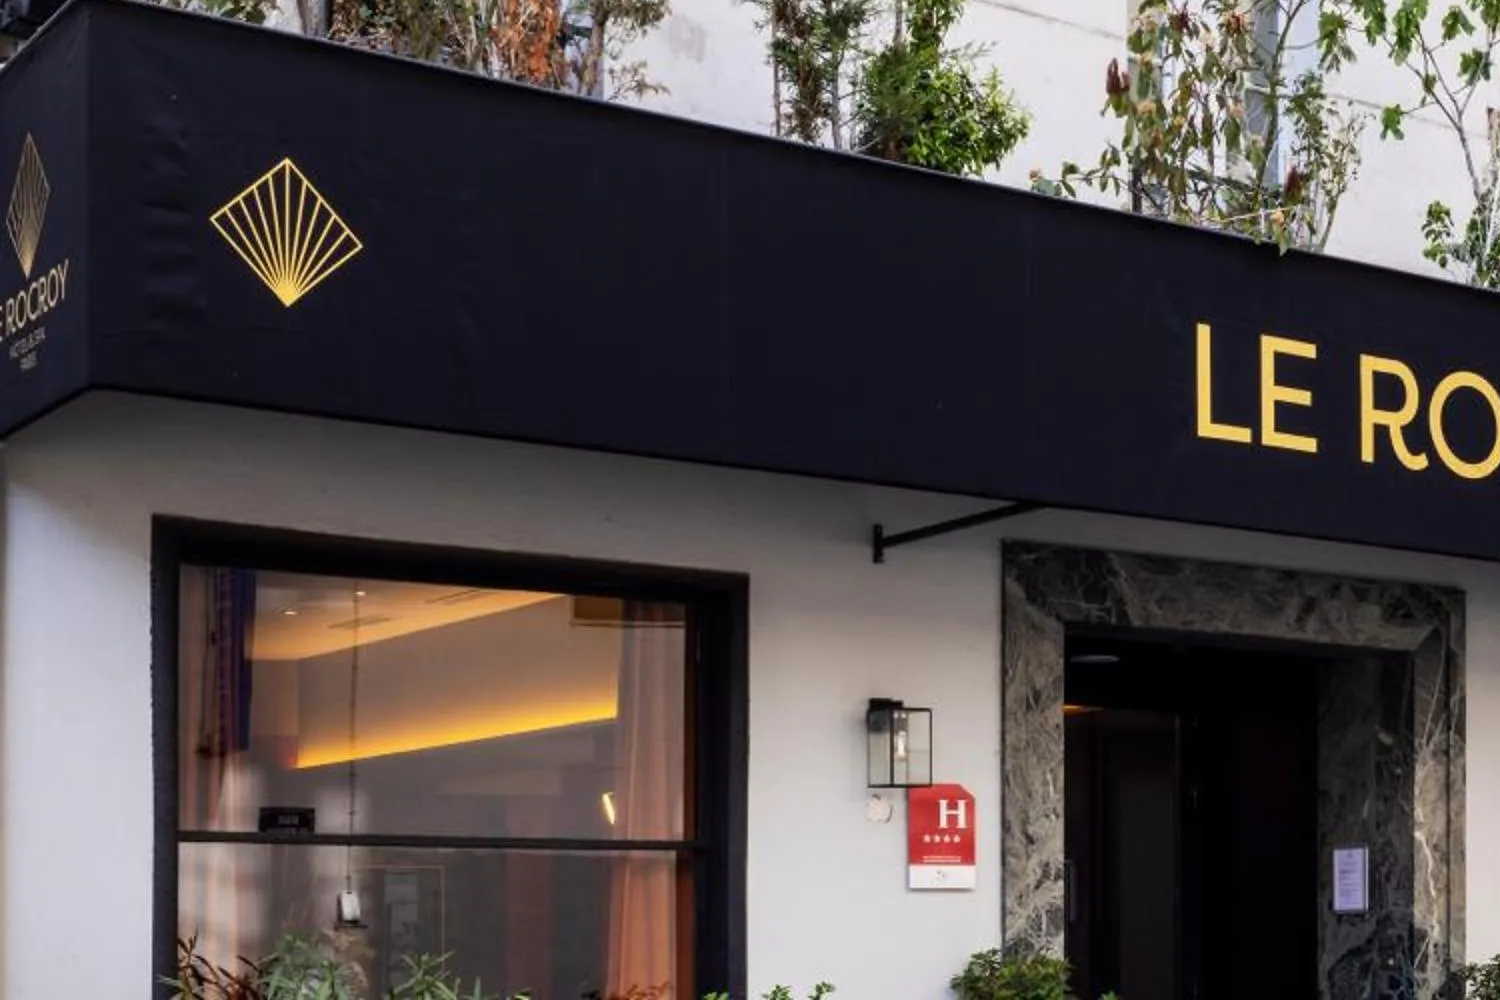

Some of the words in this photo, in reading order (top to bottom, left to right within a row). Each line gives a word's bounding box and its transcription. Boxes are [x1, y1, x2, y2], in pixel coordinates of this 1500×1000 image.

[5, 258, 69, 336] ROCROY
[1195, 322, 1318, 454] LE
[937, 798, 969, 830] H
